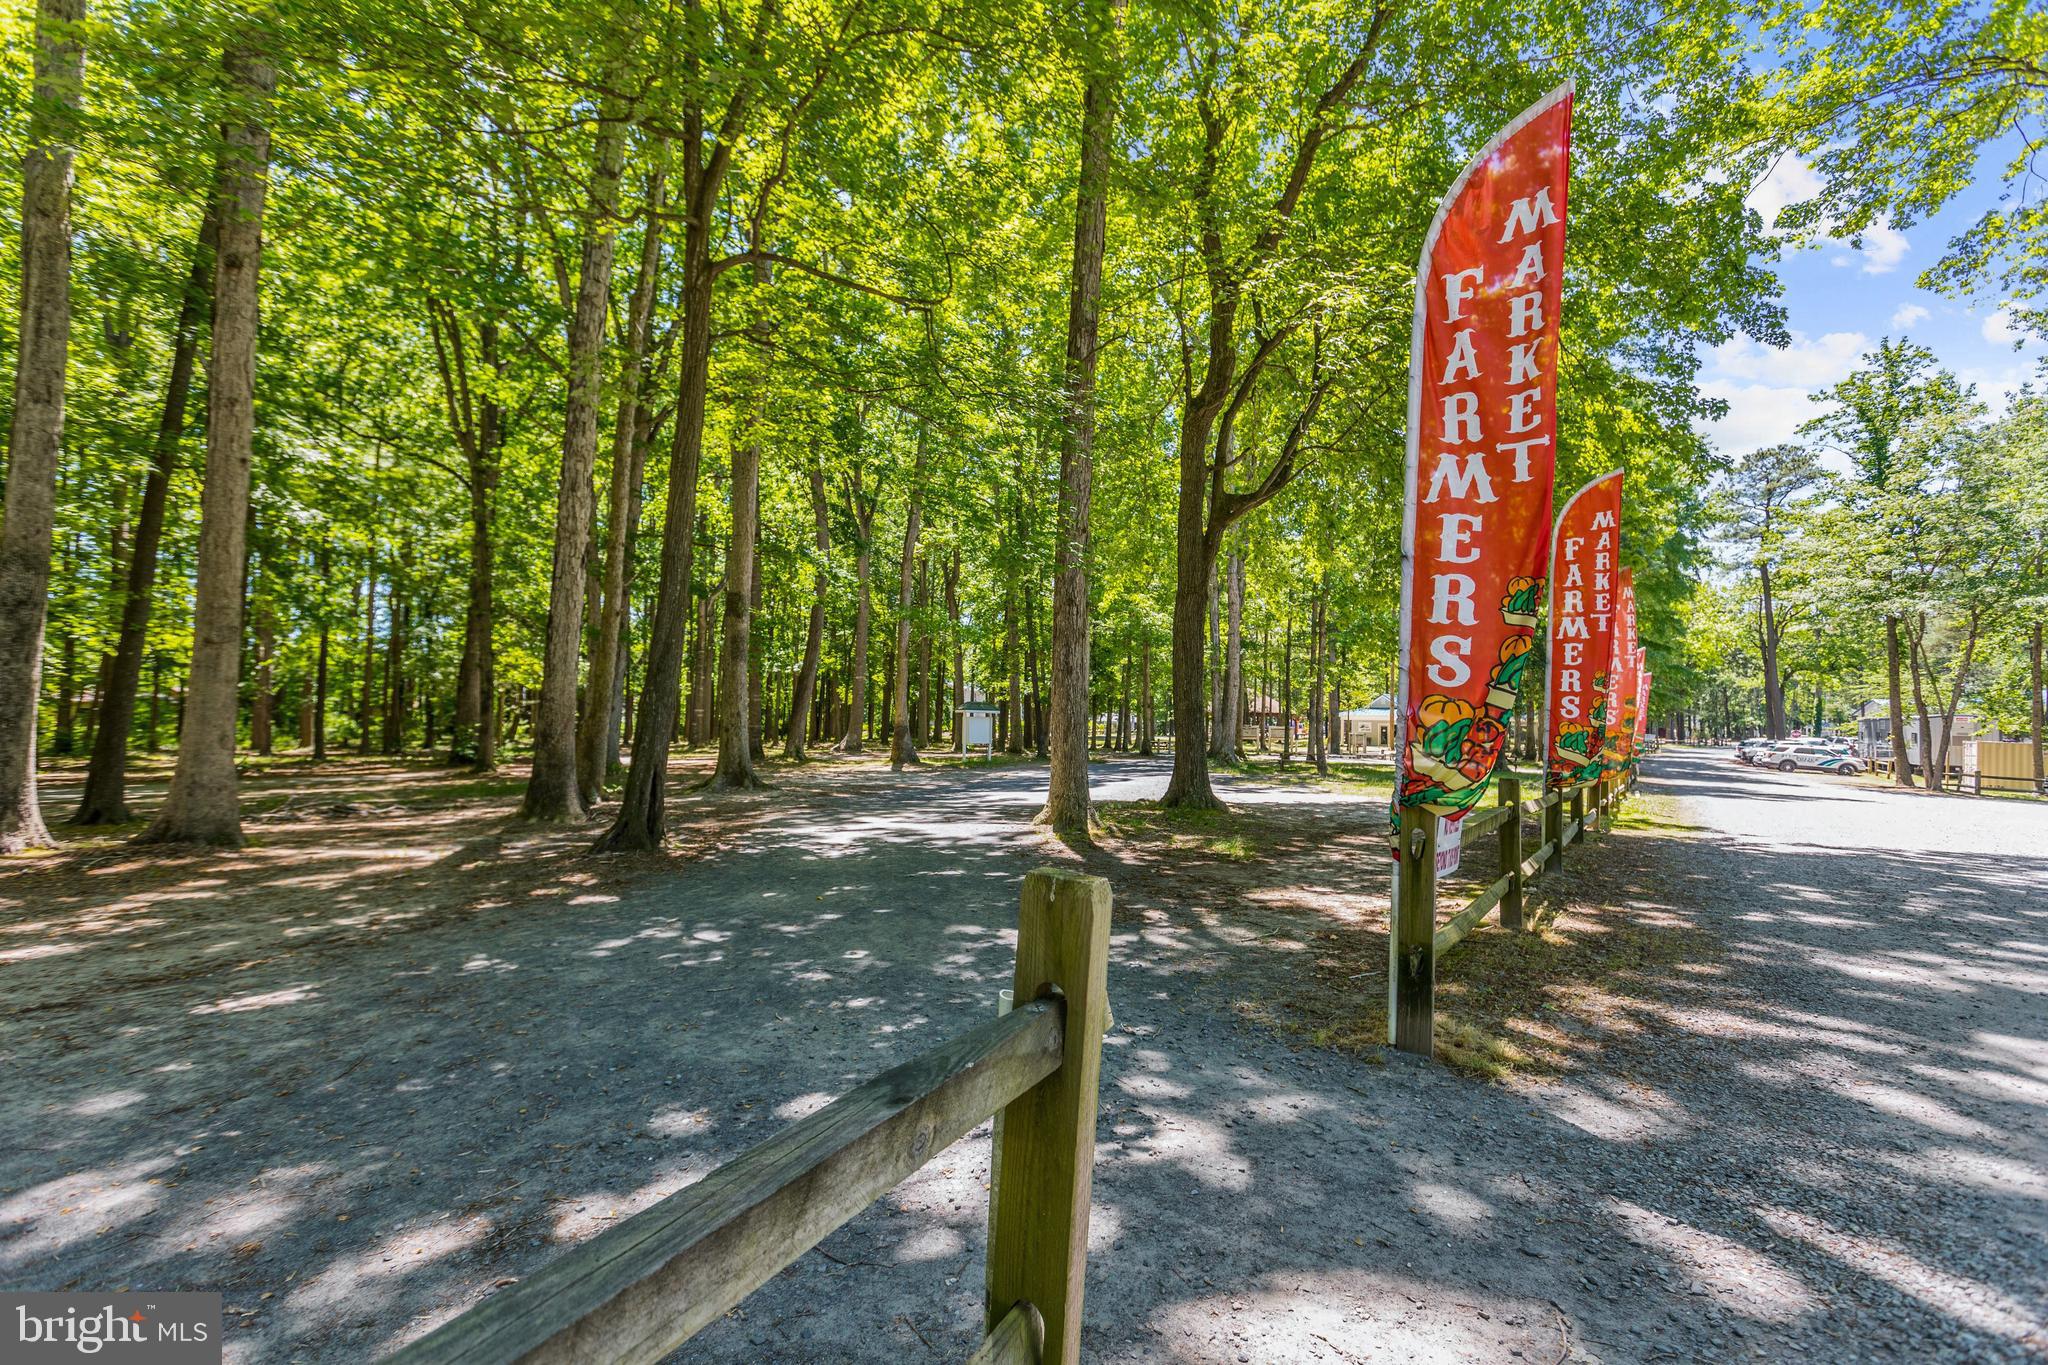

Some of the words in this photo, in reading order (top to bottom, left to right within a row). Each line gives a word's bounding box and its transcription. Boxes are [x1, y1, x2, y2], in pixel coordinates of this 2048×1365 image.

[1496, 185, 1562, 483] MARKET
[1422, 264, 1500, 688] FARMERS
[1556, 536, 1591, 719] FARMERS
[1590, 510, 1616, 633] MARKET
[1622, 586, 1637, 669] MARKET
